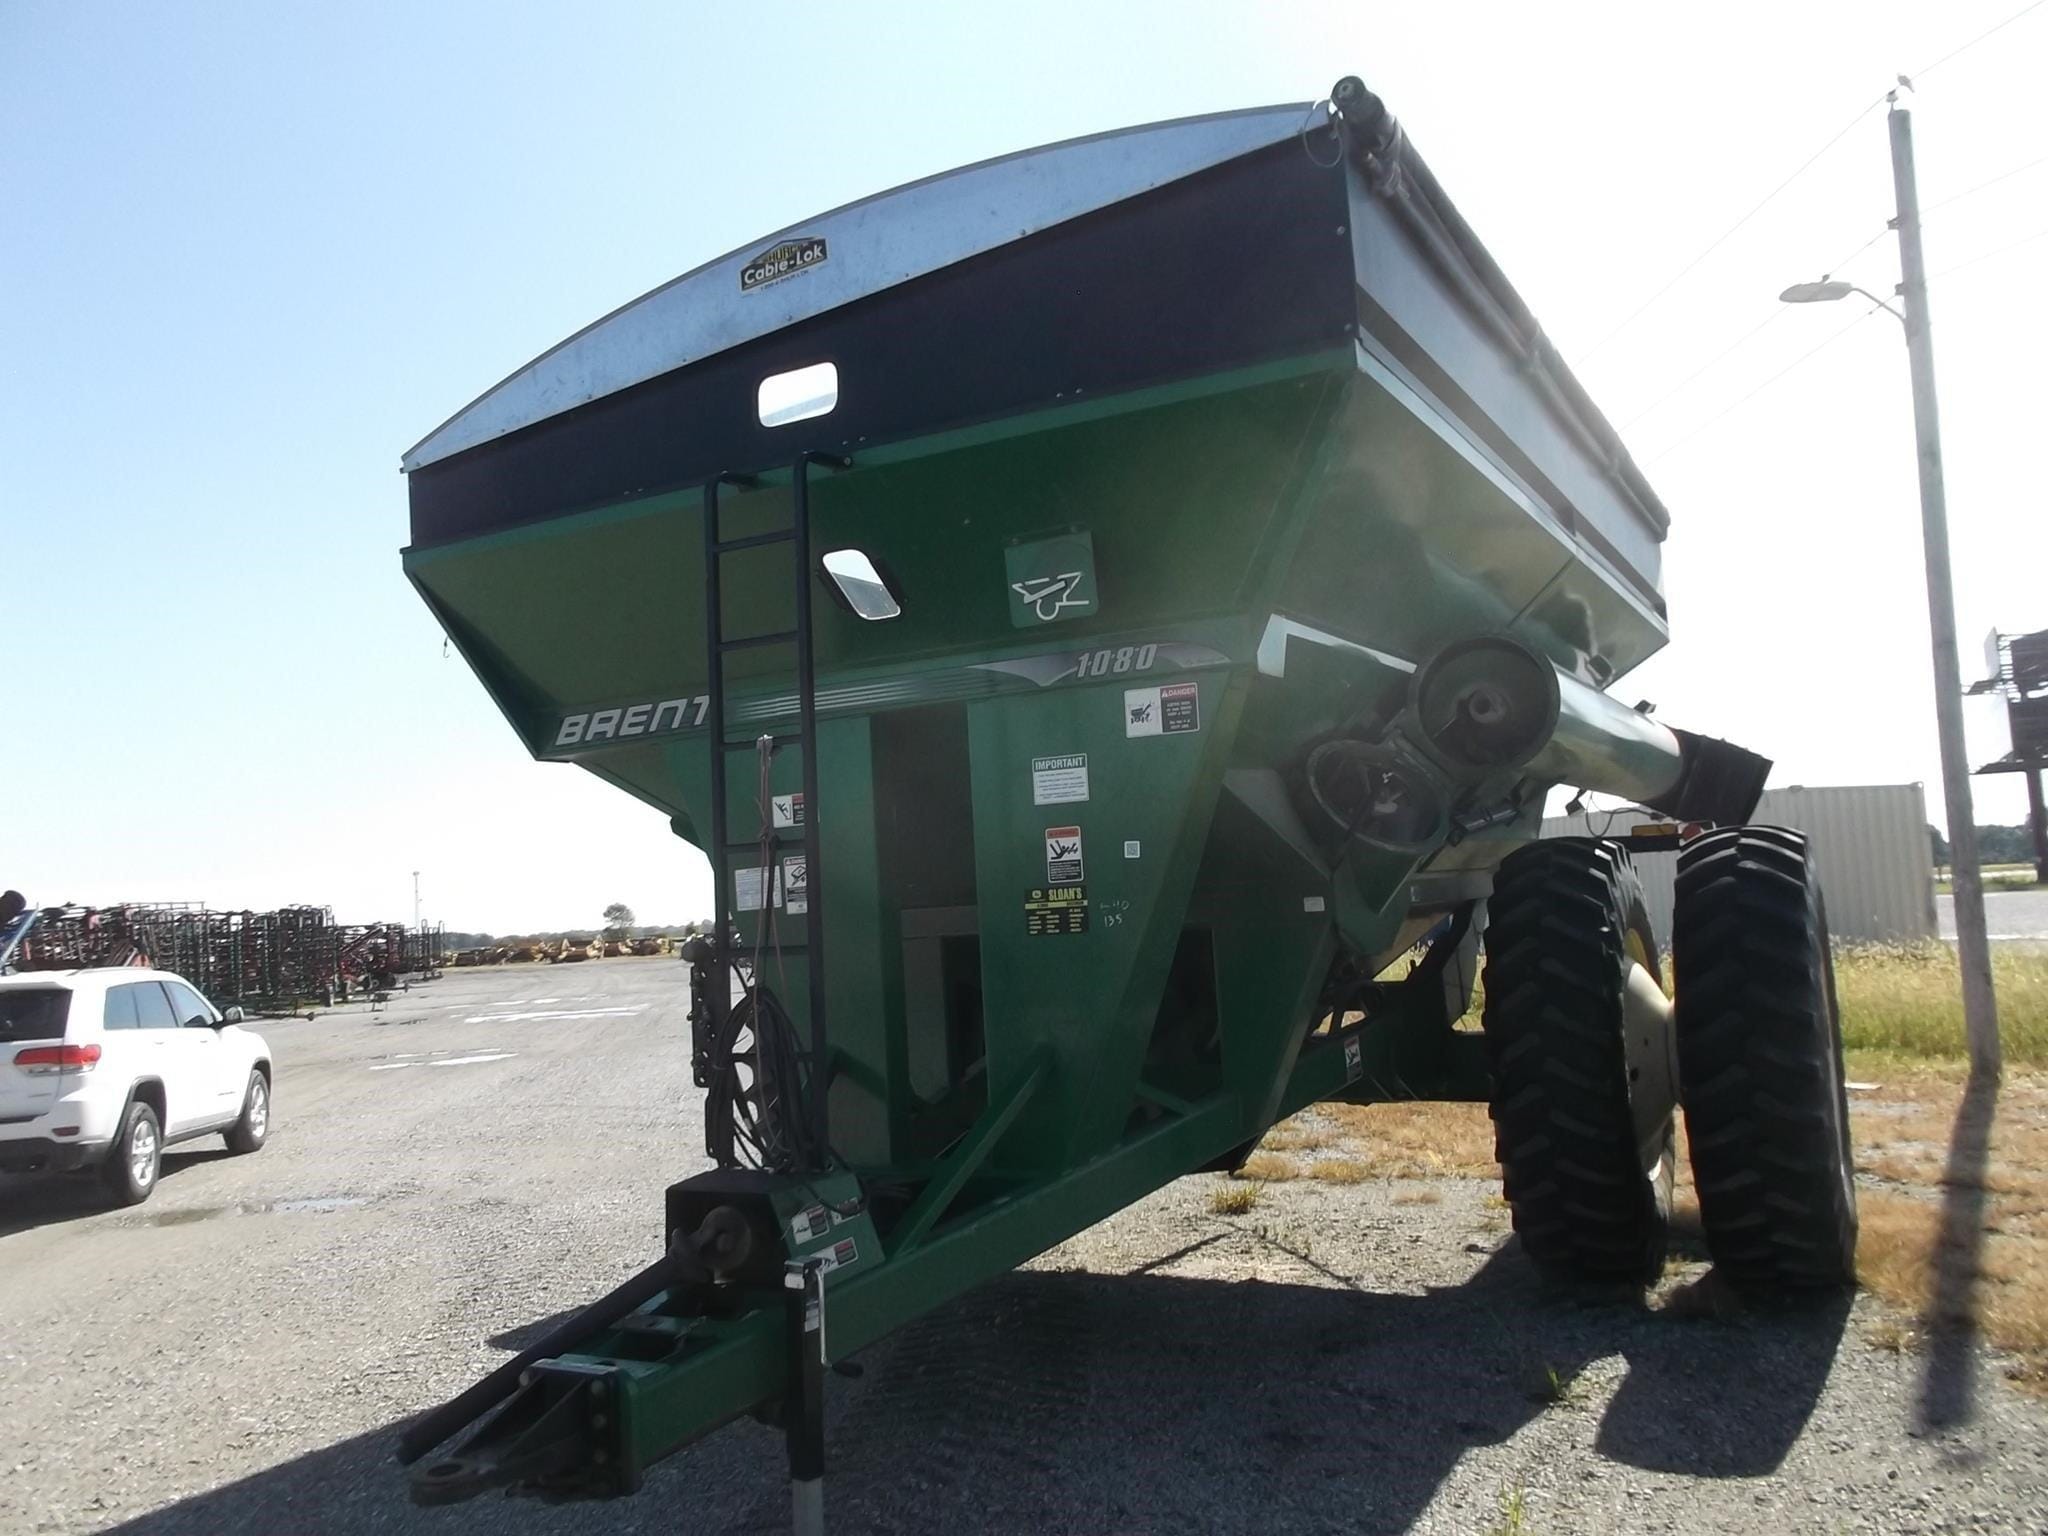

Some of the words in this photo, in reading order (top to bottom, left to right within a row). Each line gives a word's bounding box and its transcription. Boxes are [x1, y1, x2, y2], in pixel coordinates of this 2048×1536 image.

[744, 244, 823, 284] Cable-Lok
[1077, 644, 1157, 678] 1080
[1168, 687, 1195, 697] DANGER
[555, 695, 710, 746] BRENT
[1035, 756, 1084, 771] IMPORTANT
[1048, 887, 1083, 901] SLOAN'S
